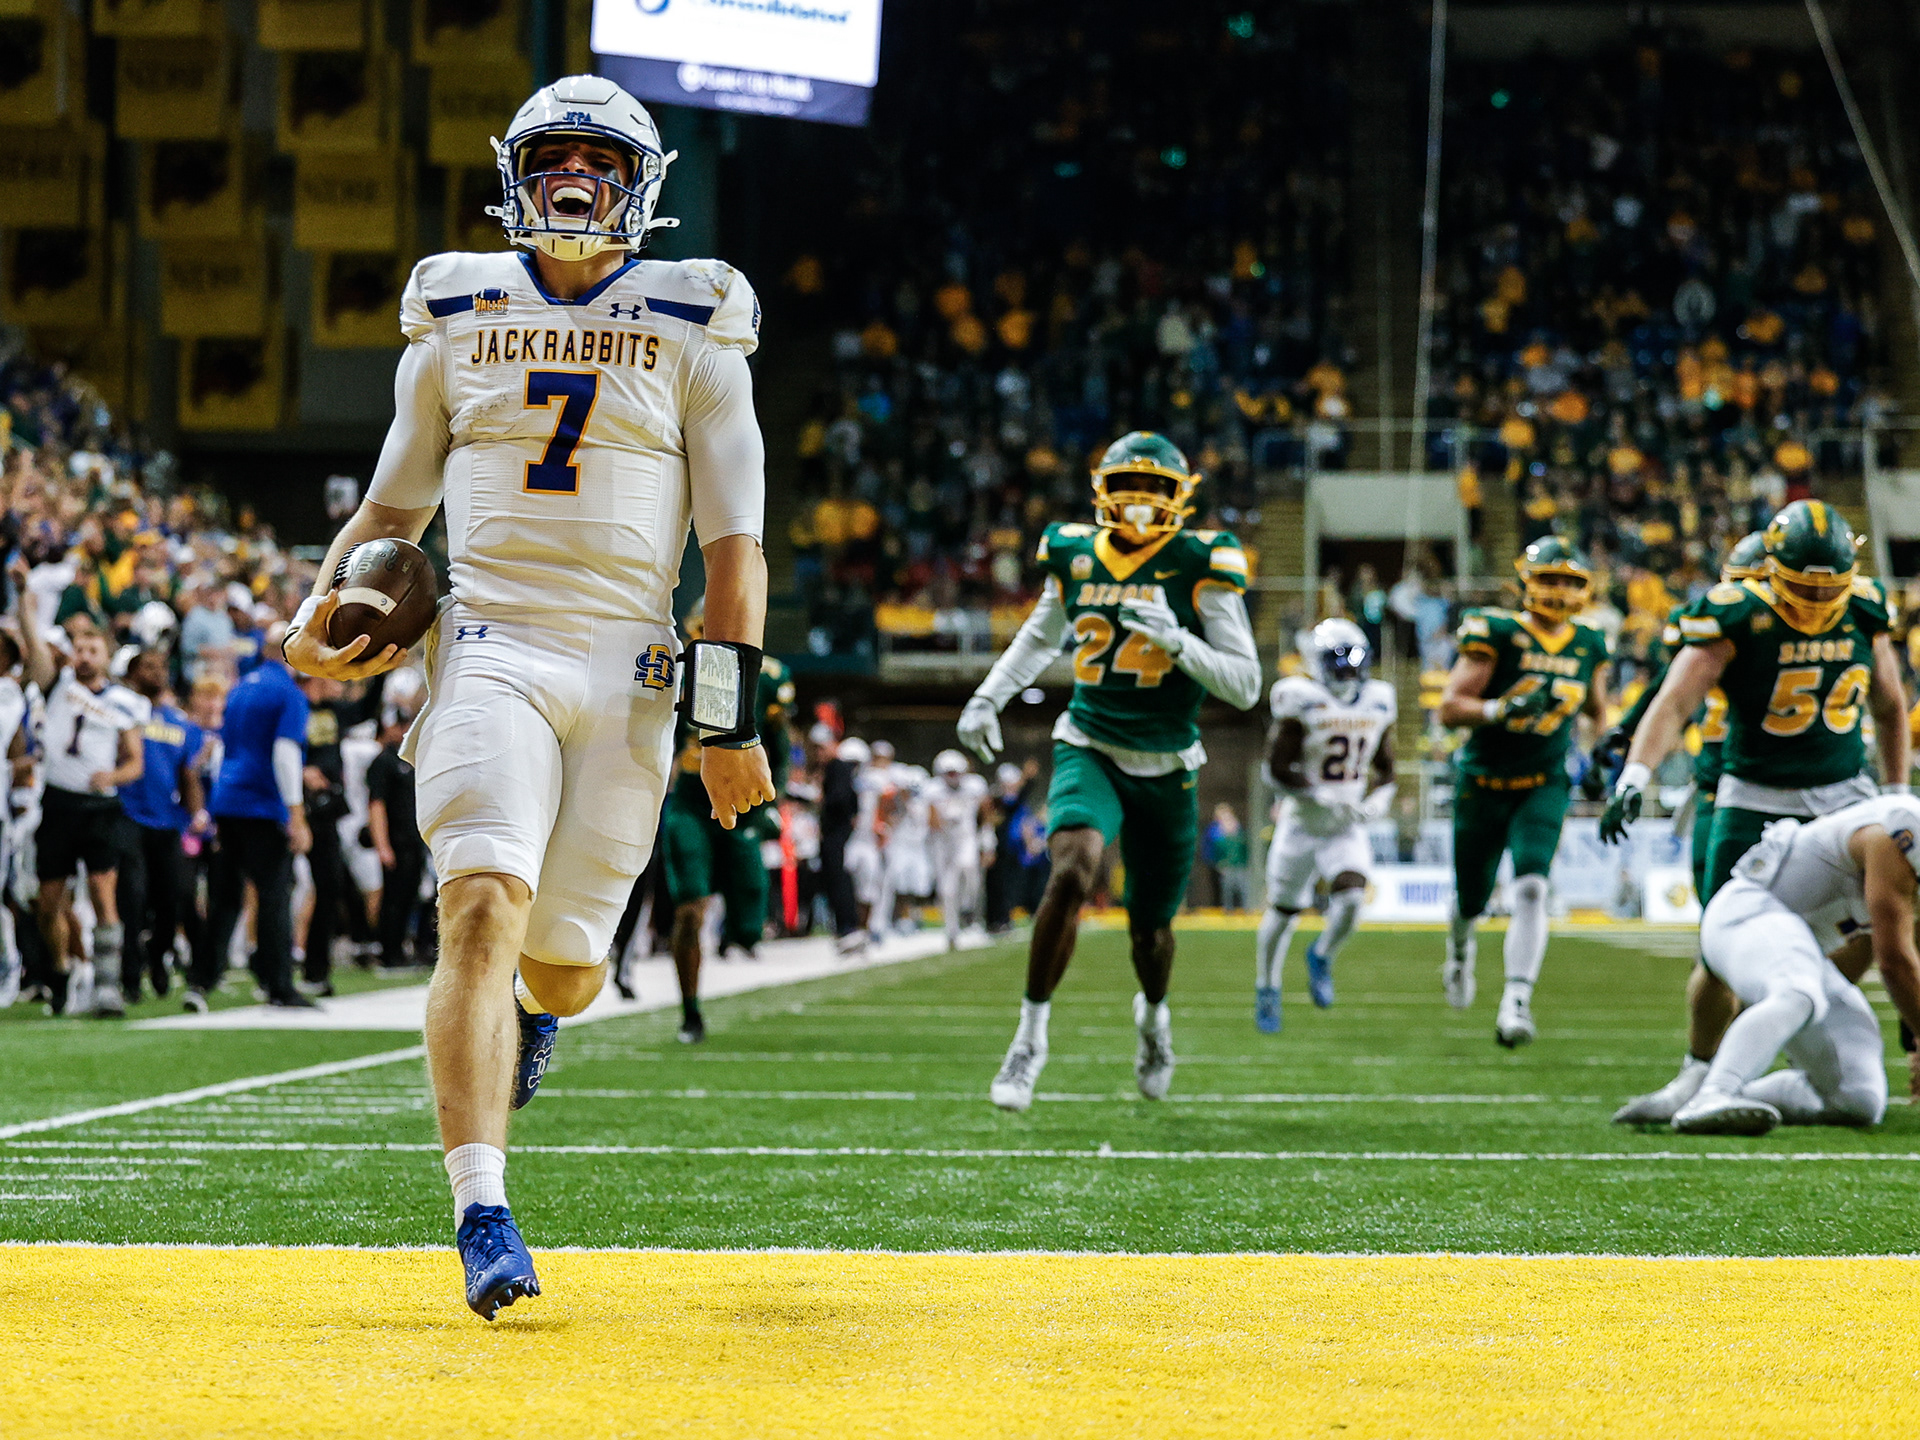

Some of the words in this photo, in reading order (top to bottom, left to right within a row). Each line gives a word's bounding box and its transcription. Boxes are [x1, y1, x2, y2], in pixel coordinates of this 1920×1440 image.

[475, 296, 509, 312] VALLEY
[471, 330, 659, 371] JACKRABBITS
[523, 369, 601, 496] 7
[1073, 611, 1173, 688] 24
[1778, 638, 1855, 663] BISON
[1322, 734, 1366, 781] 21
